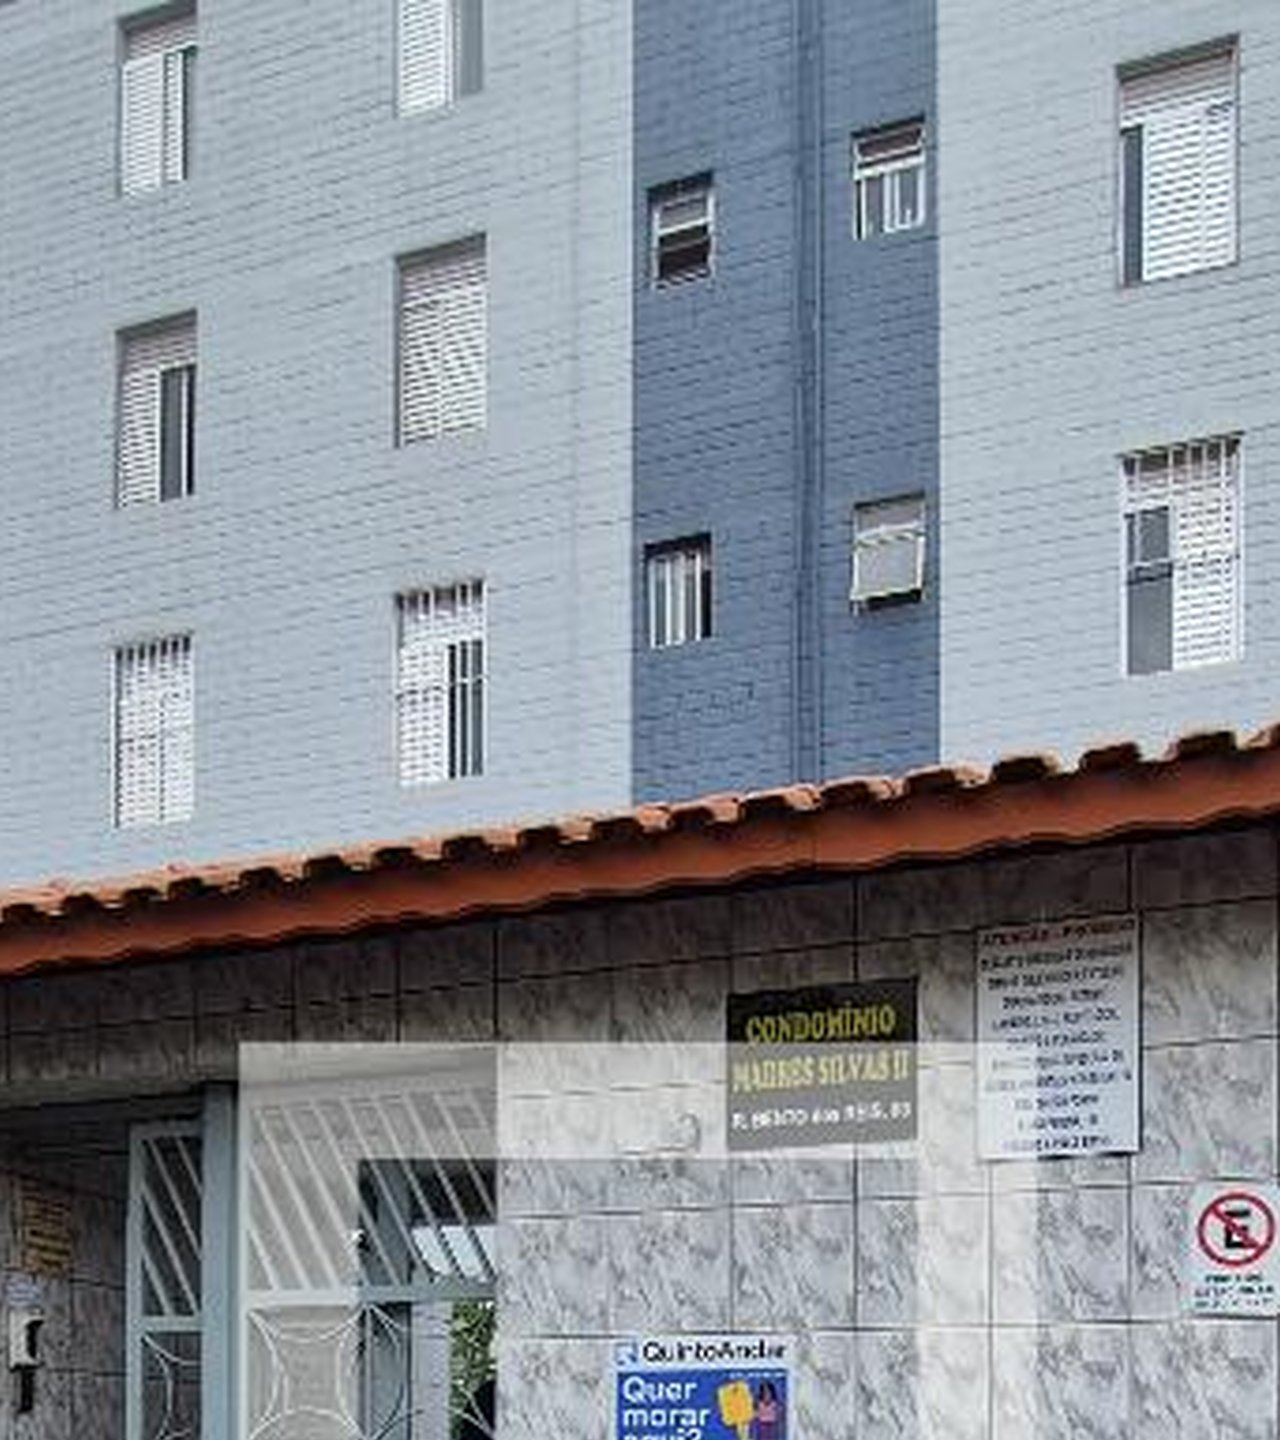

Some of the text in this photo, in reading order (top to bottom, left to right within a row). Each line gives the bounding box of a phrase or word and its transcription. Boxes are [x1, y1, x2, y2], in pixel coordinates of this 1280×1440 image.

[746, 1003, 896, 1042] CONDOMÍNIO
[818, 1051, 889, 1085] SILVAS
[1225, 1209, 1258, 1249] E
[642, 1339, 786, 1362] QuintoAndar
[623, 1376, 697, 1403] Quer
[623, 1408, 711, 1427] morar
